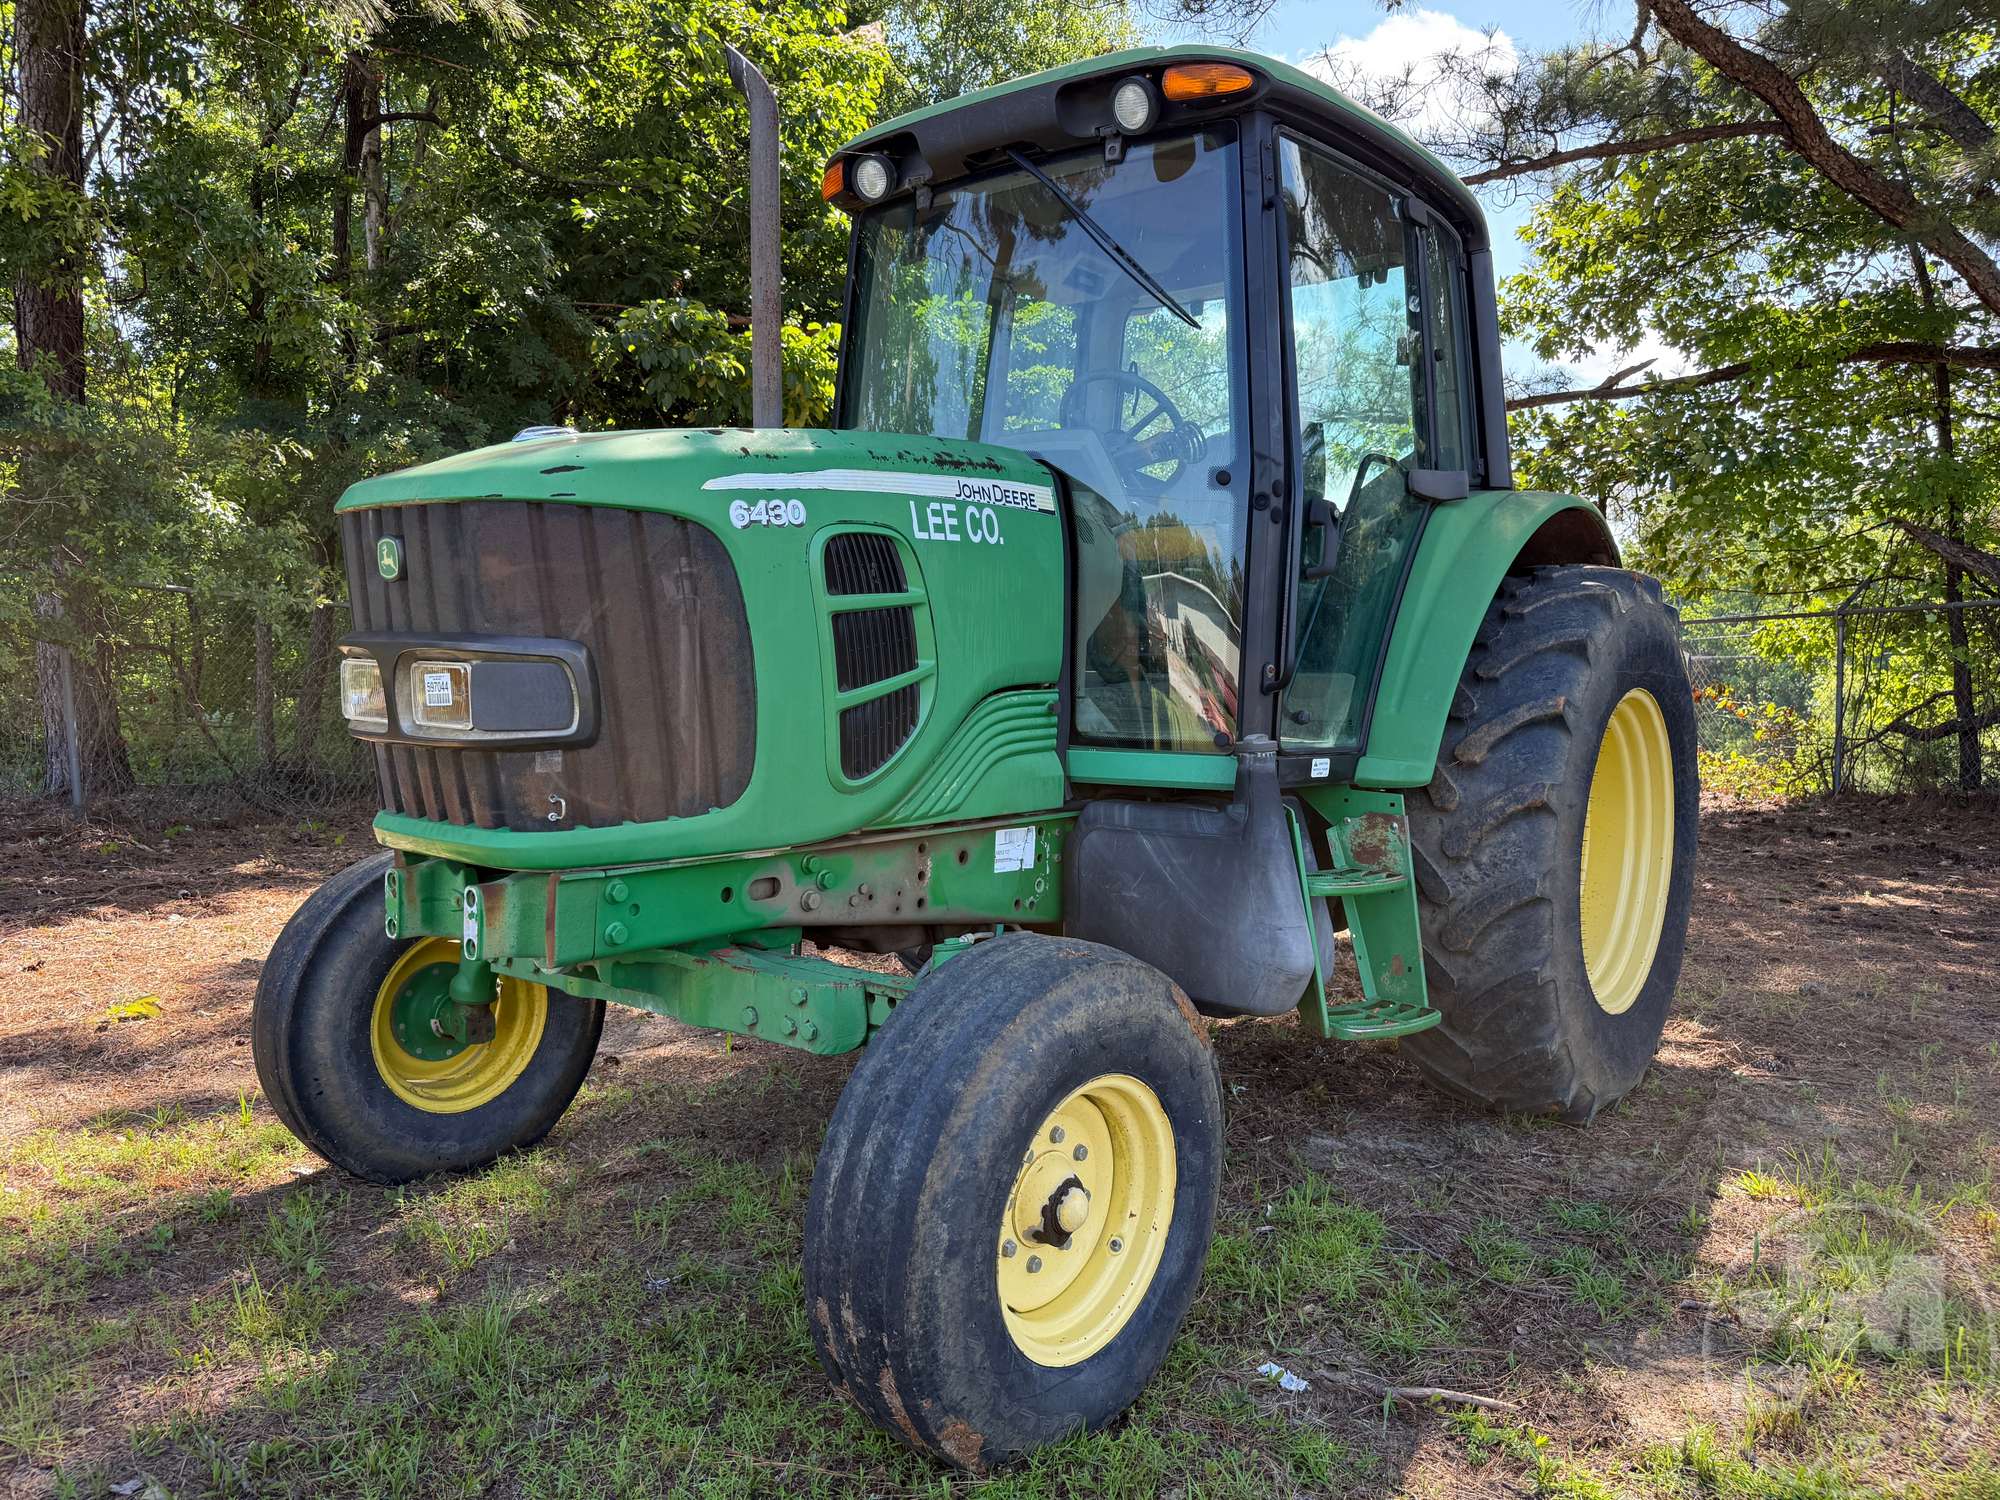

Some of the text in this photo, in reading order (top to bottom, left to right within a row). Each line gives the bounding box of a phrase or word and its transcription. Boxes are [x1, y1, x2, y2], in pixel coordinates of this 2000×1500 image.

[955, 480, 1037, 508] JOHN DEERE
[729, 499, 806, 529] 6430
[909, 500, 1004, 545] LEE CO.
